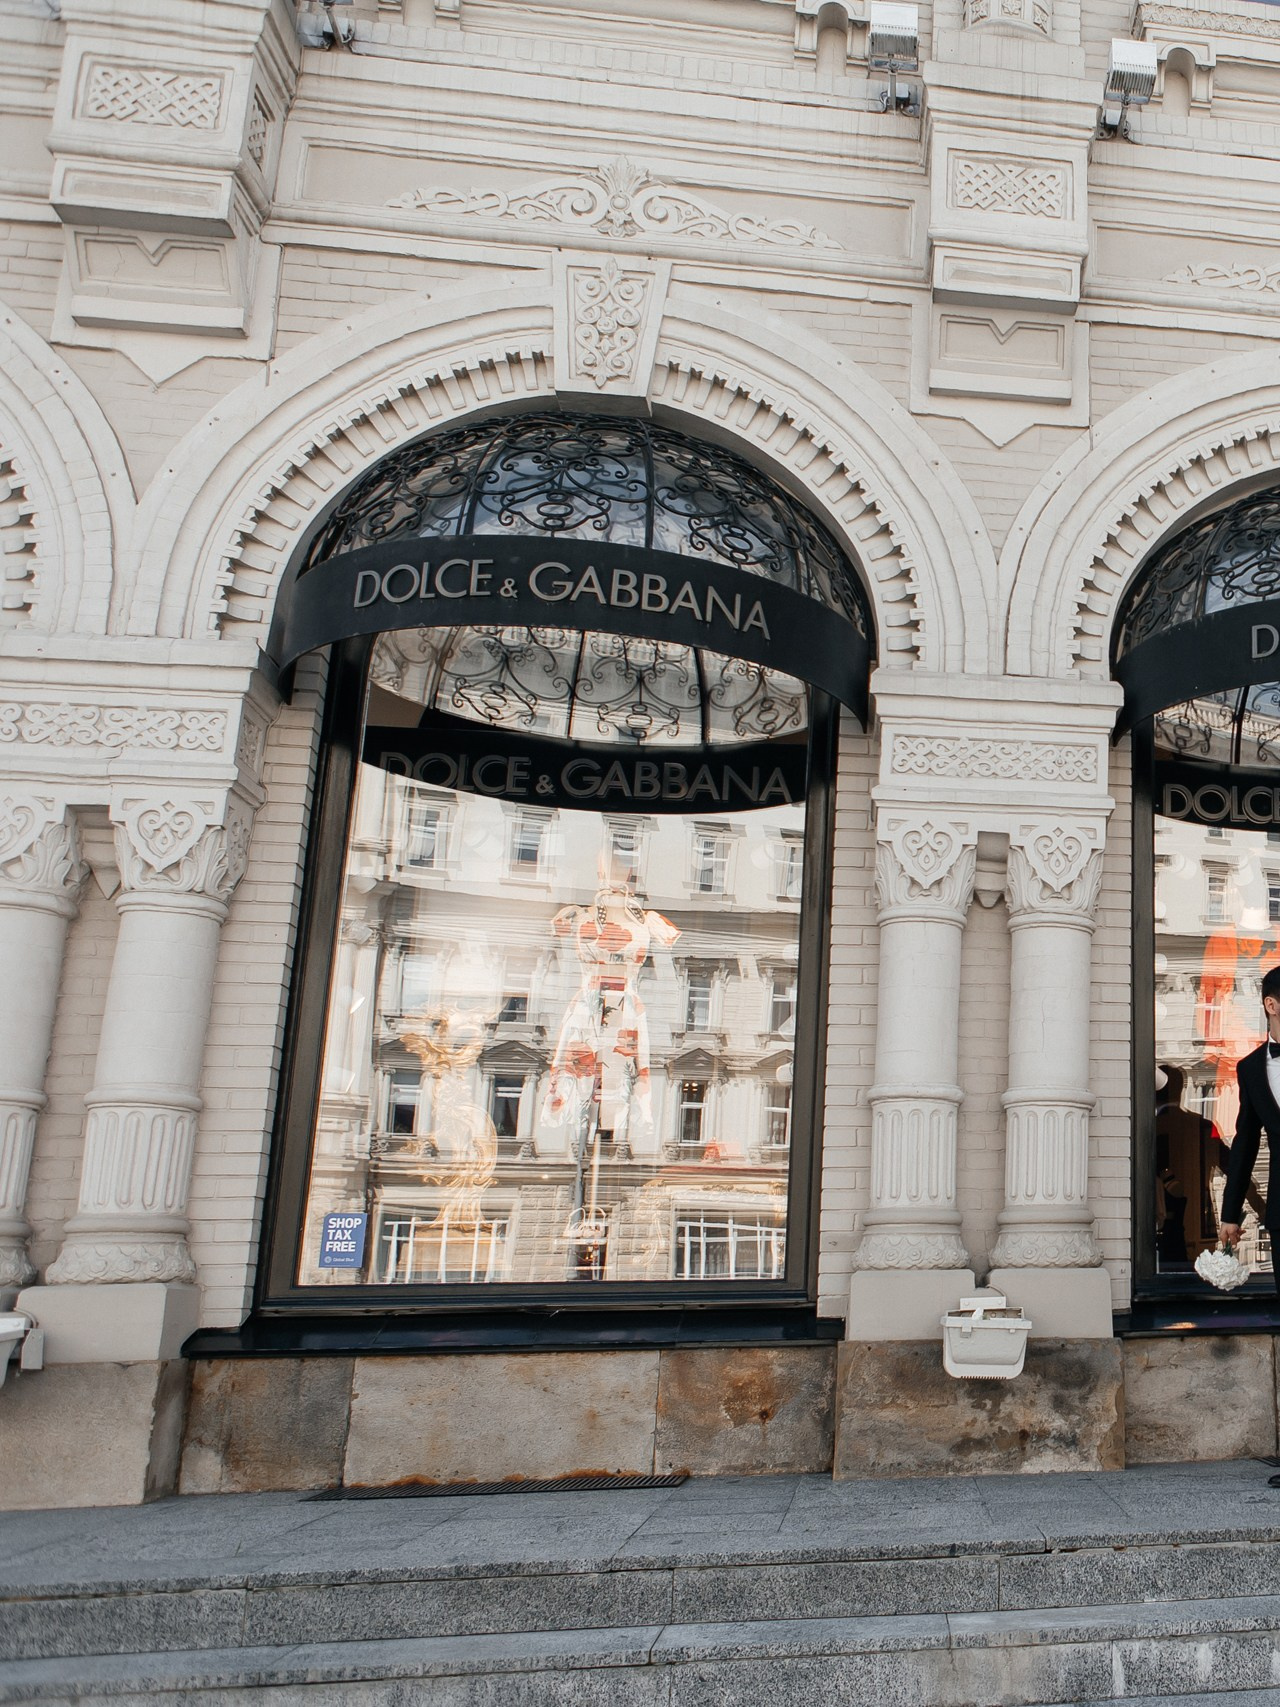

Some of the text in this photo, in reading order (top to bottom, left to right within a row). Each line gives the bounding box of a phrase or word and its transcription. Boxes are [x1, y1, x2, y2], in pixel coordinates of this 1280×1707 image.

[354, 559, 770, 640] DOLCE & GABBANA
[380, 751, 530, 796] DOLCE
[560, 758, 792, 802] GABBANA
[328, 1217, 362, 1229] SHOP
[327, 1230, 352, 1240] TAX
[325, 1241, 357, 1252] FREE
